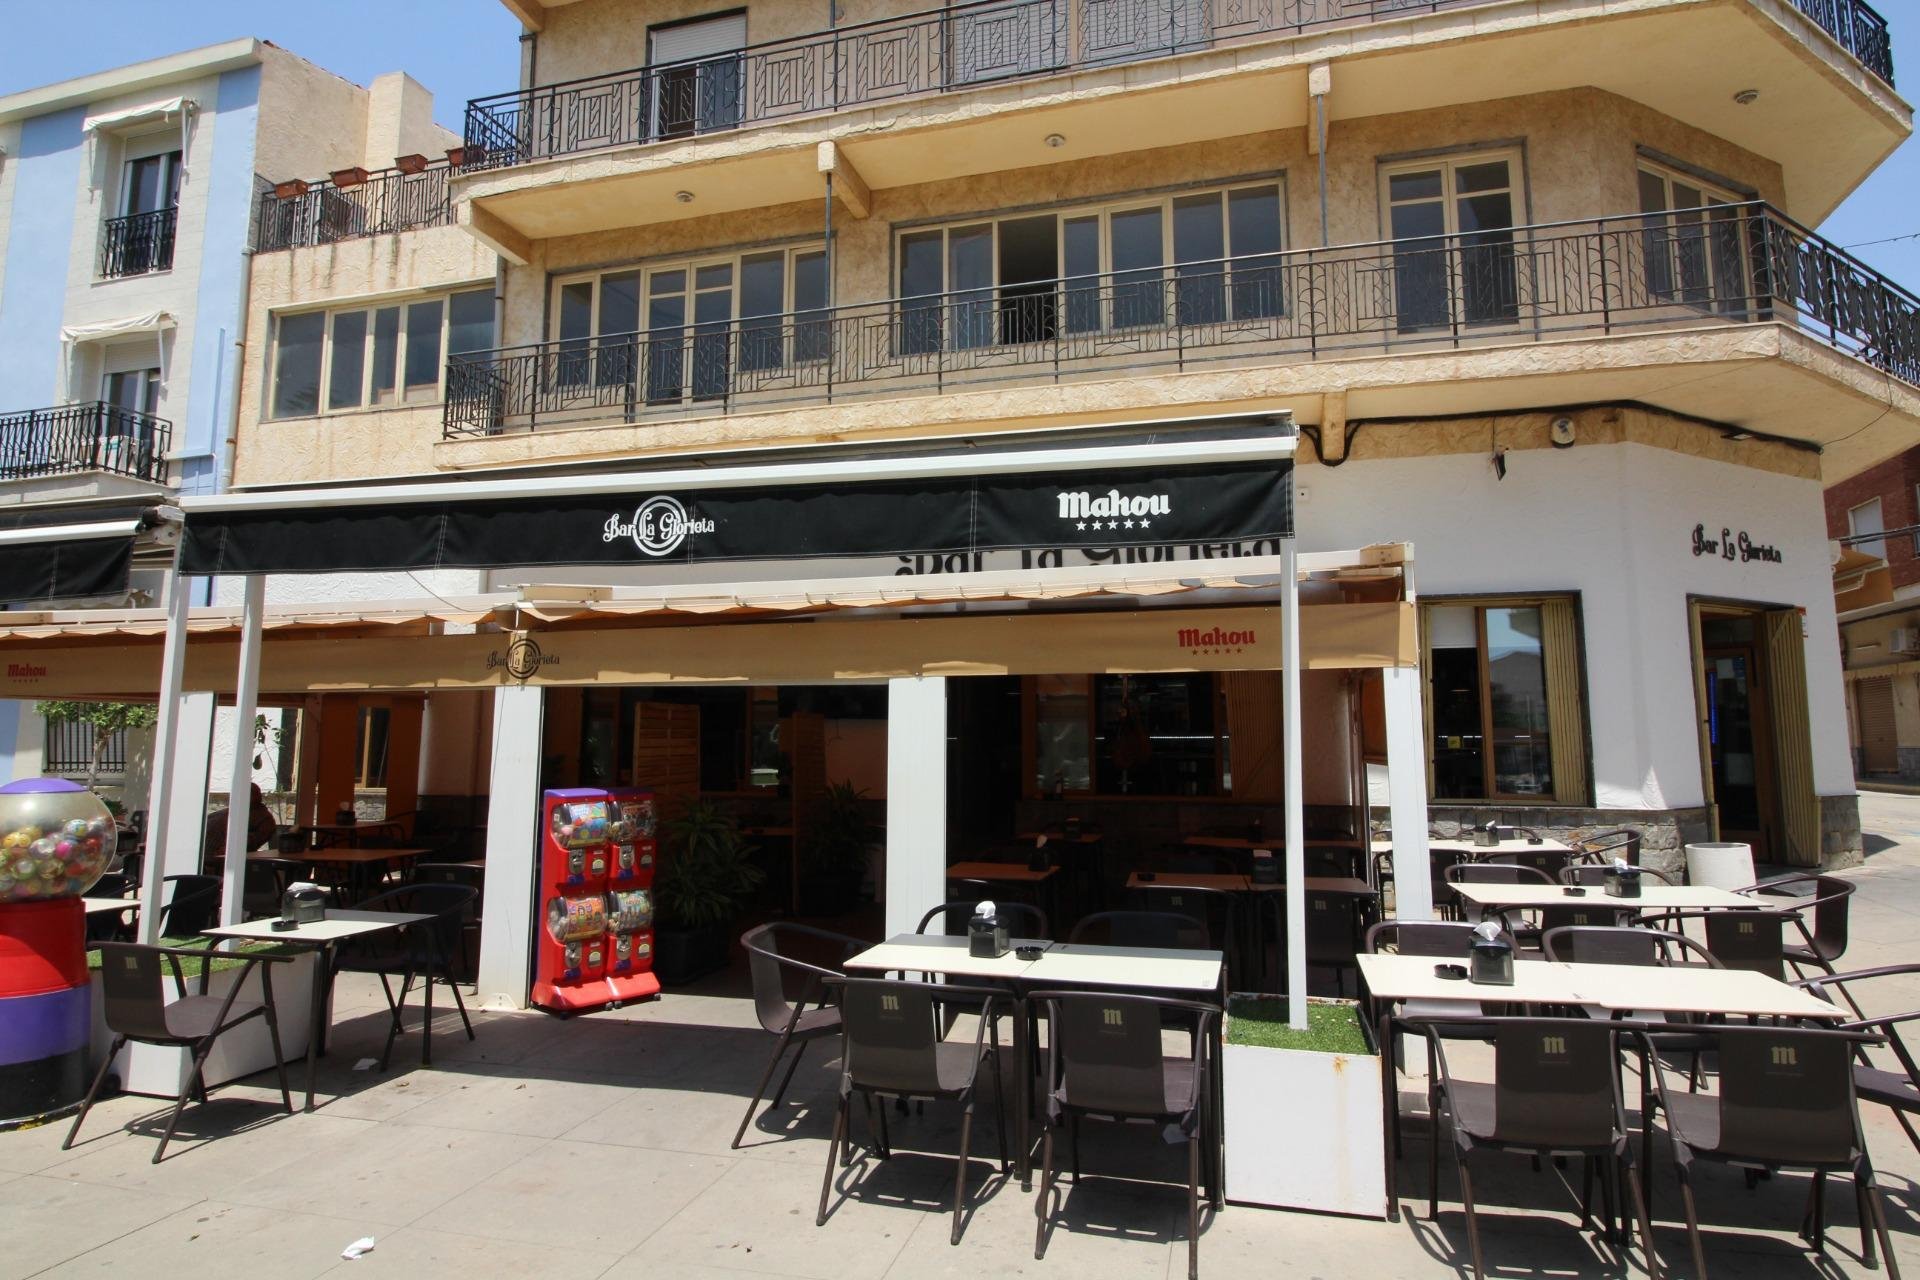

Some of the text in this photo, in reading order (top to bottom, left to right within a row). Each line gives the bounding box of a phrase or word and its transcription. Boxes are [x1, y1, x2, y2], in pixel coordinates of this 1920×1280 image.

[603, 512, 715, 542] Bar La Glorieta
[1692, 523, 1718, 556] Bar
[1722, 528, 1736, 560] La
[487, 650, 507, 670] Bar
[1542, 1037, 1566, 1054] m
[1771, 1047, 1798, 1065] m
